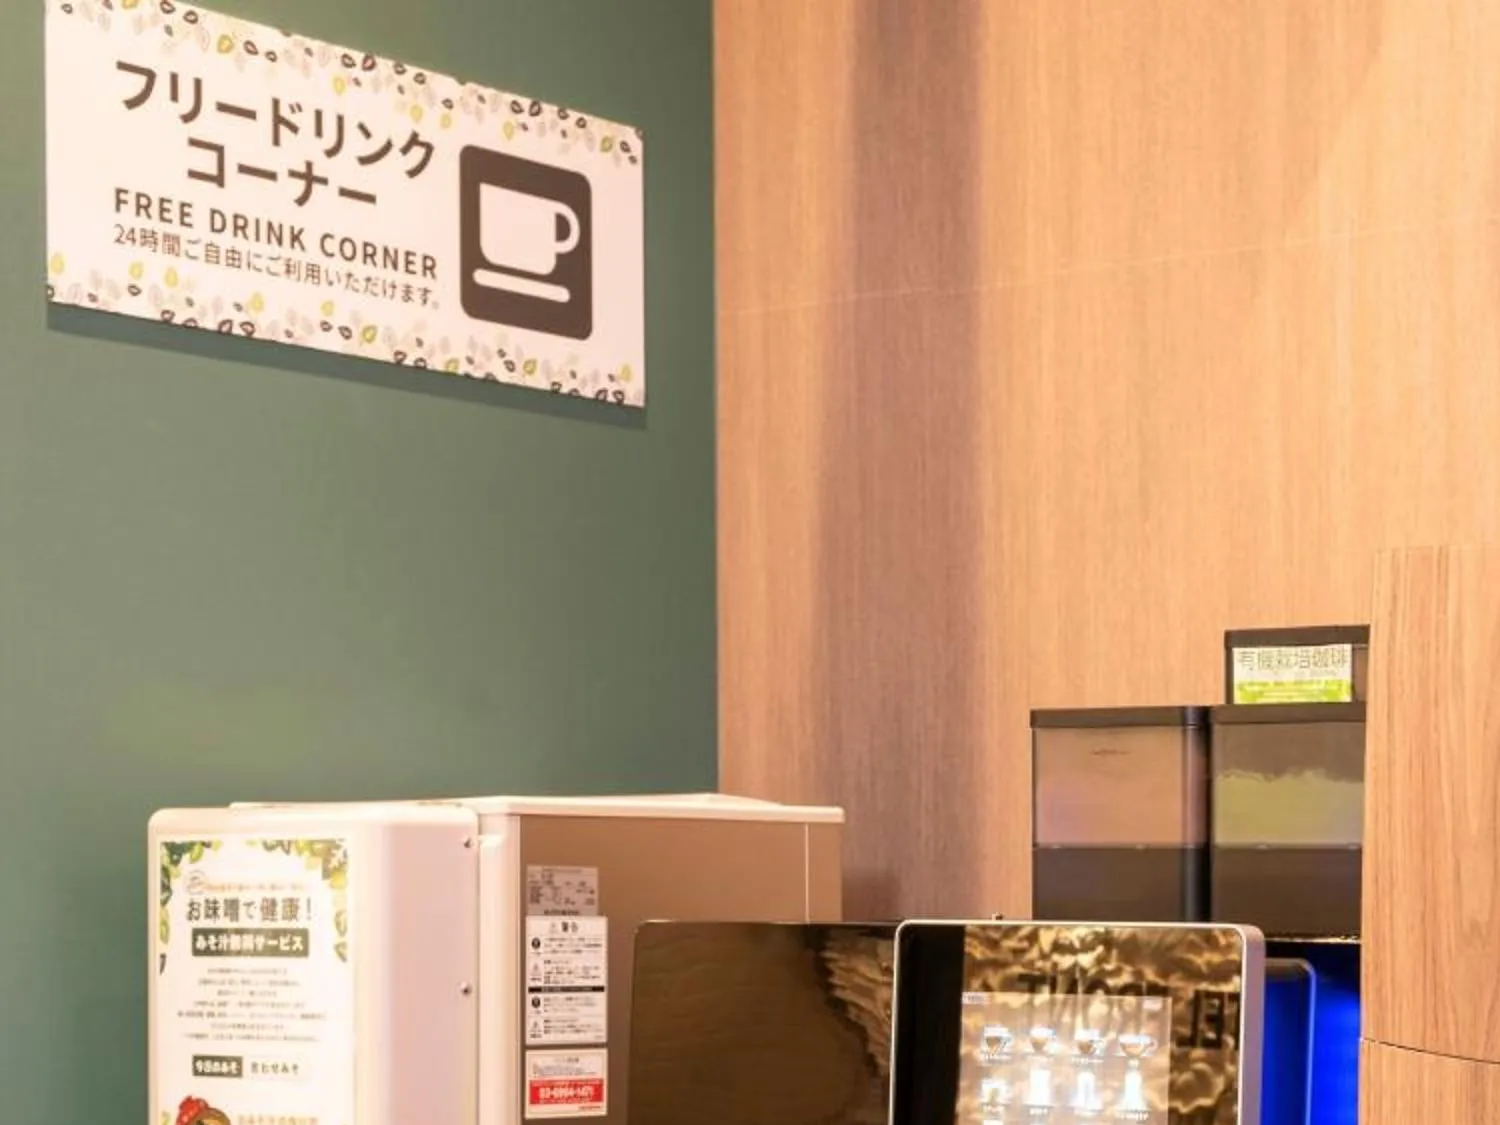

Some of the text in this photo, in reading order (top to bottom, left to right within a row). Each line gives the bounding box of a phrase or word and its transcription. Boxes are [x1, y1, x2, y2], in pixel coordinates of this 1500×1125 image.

[115, 60, 436, 179] フリードリンク
[186, 136, 378, 208] コーナー
[113, 187, 438, 280] FREE DRINK CORNER
[113, 223, 440, 310] 24時間ご自由にご利用いただけます。
